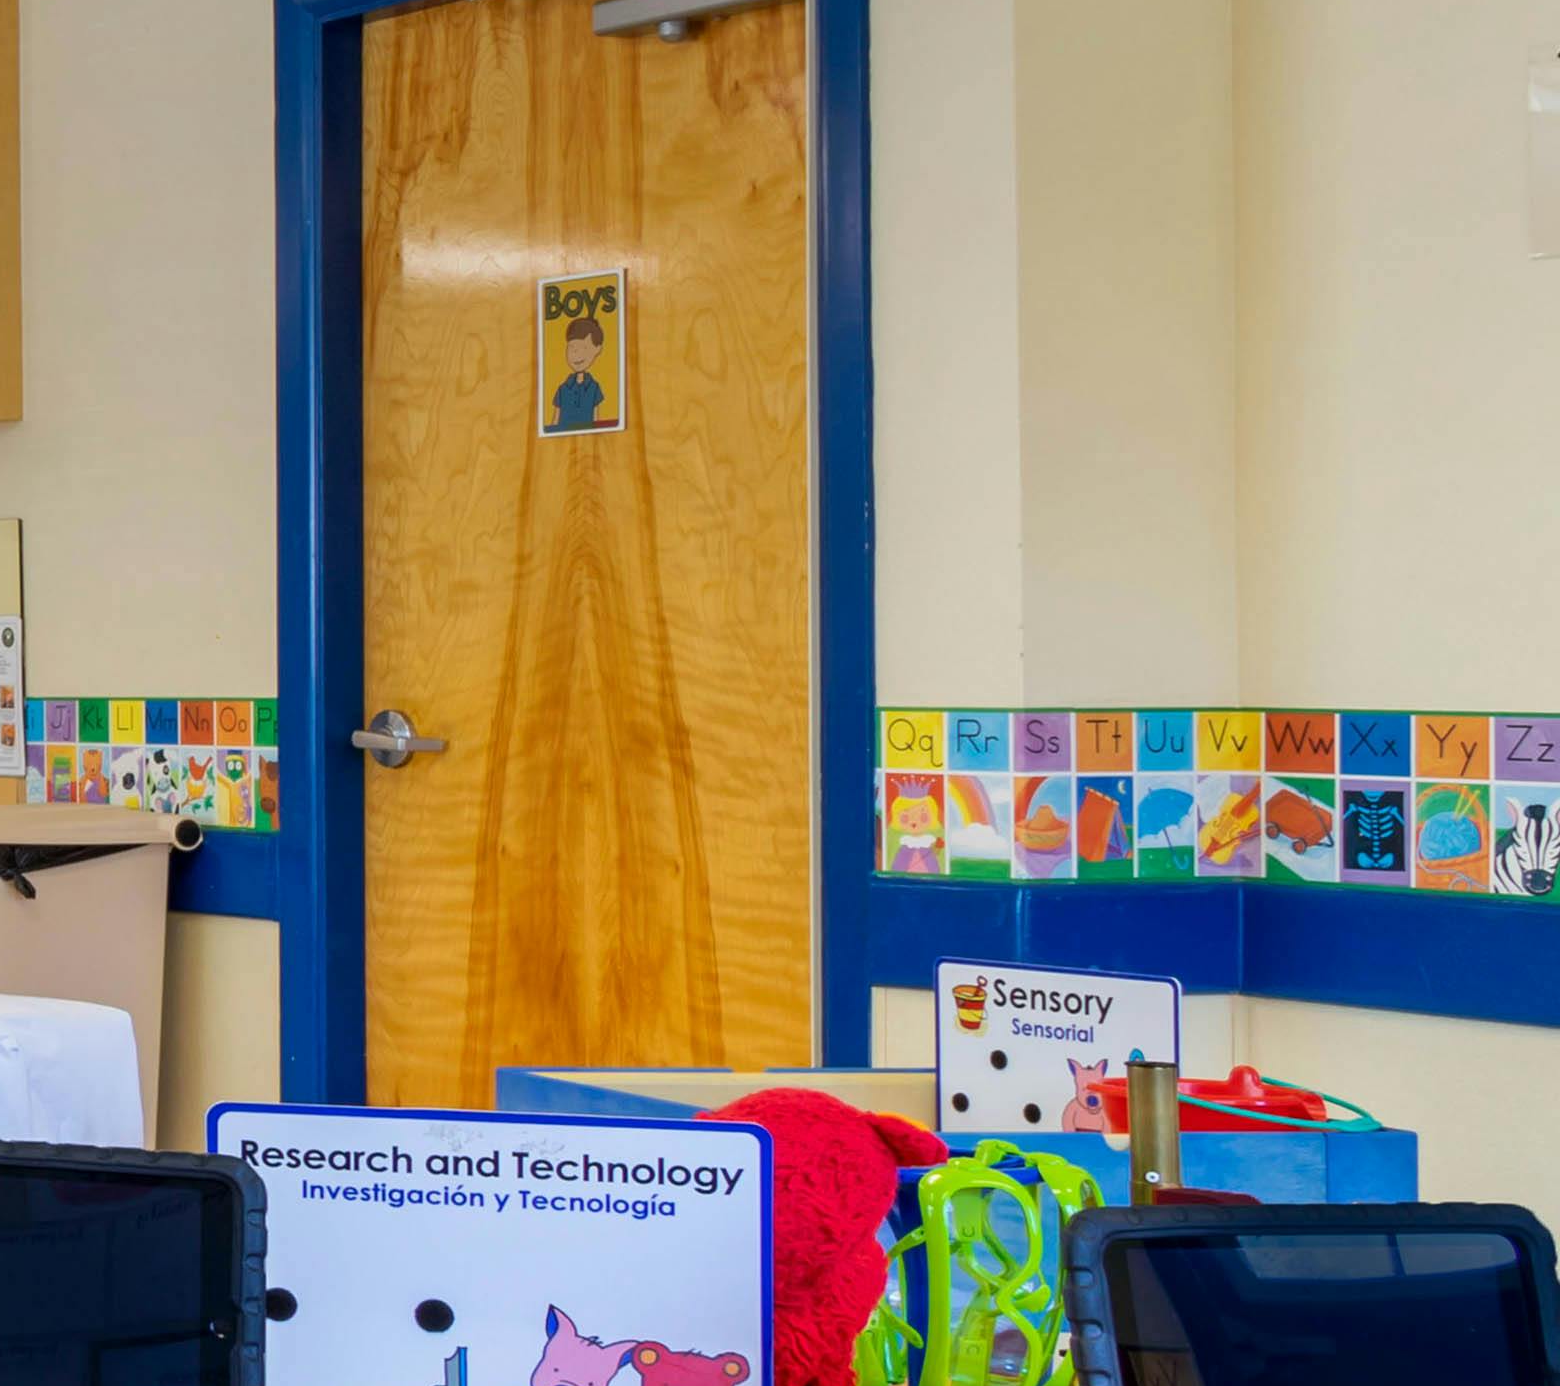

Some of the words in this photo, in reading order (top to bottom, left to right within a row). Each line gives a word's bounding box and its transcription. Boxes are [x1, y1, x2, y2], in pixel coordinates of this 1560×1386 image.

[50, 705, 70, 741] Jj
[83, 705, 105, 731] Kk
[116, 706, 134, 731] Ll
[184, 707, 210, 732] Nn
[219, 707, 247, 733] Oo
[886, 718, 944, 768] Qq
[955, 718, 1000, 755] Rr
[1024, 718, 1061, 754] Ss
[1085, 718, 1123, 754] Tt
[1143, 718, 1186, 754] Uu
[1206, 718, 1250, 753] Vv
[1266, 718, 1336, 756] Ww
[1348, 720, 1399, 760] Xx
[1426, 722, 1477, 776] Yy
[1504, 724, 1556, 763] Zz
[993, 977, 1114, 1024] Sensory
[1011, 1017, 1095, 1044] Sensorial
[240, 1139, 414, 1175] Research
[425, 1145, 500, 1179] and
[513, 1149, 744, 1196] Technology
[301, 1179, 485, 1211] Investigación
[494, 1189, 510, 1213] y
[518, 1189, 677, 1220] Tecnología
